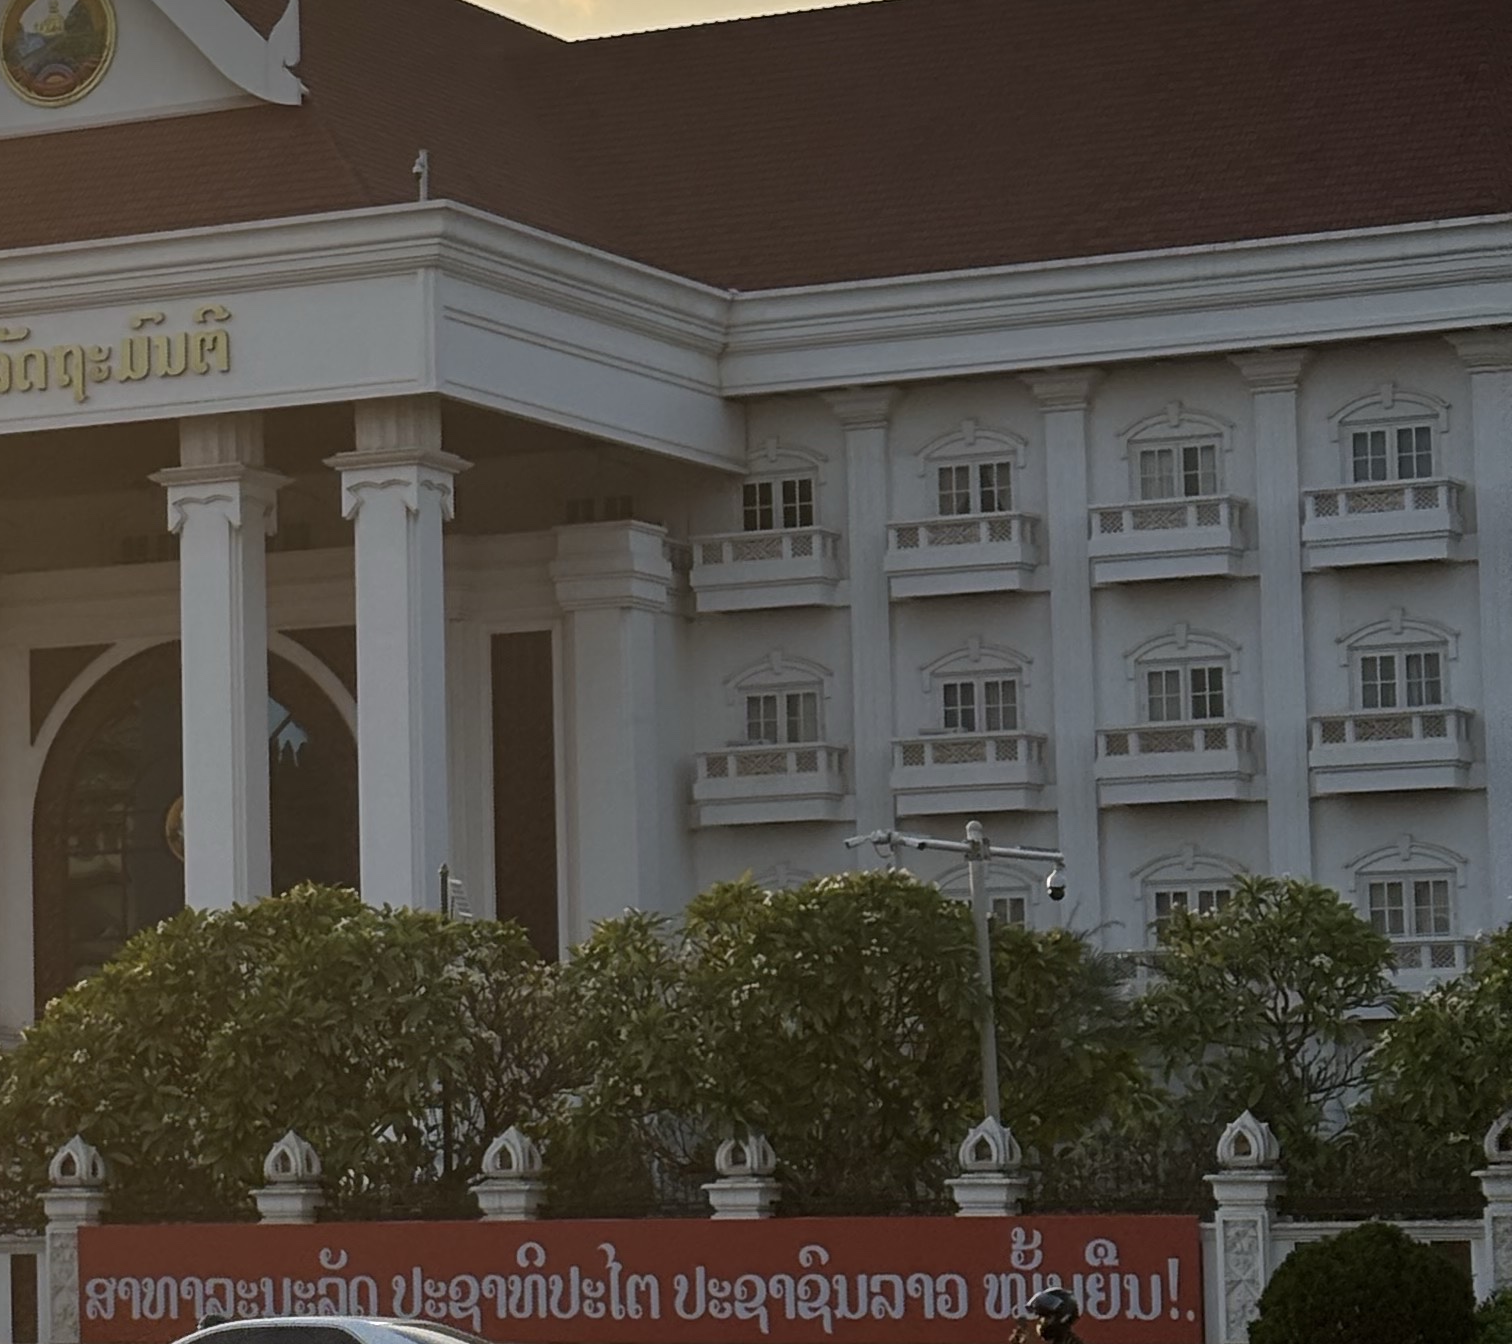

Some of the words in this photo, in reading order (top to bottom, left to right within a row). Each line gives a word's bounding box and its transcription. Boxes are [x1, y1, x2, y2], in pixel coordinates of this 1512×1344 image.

[391, 1240, 661, 1333] ປະຊາທິປະໄຕ
[673, 1244, 969, 1335] ປະຊາຊົນລາວ
